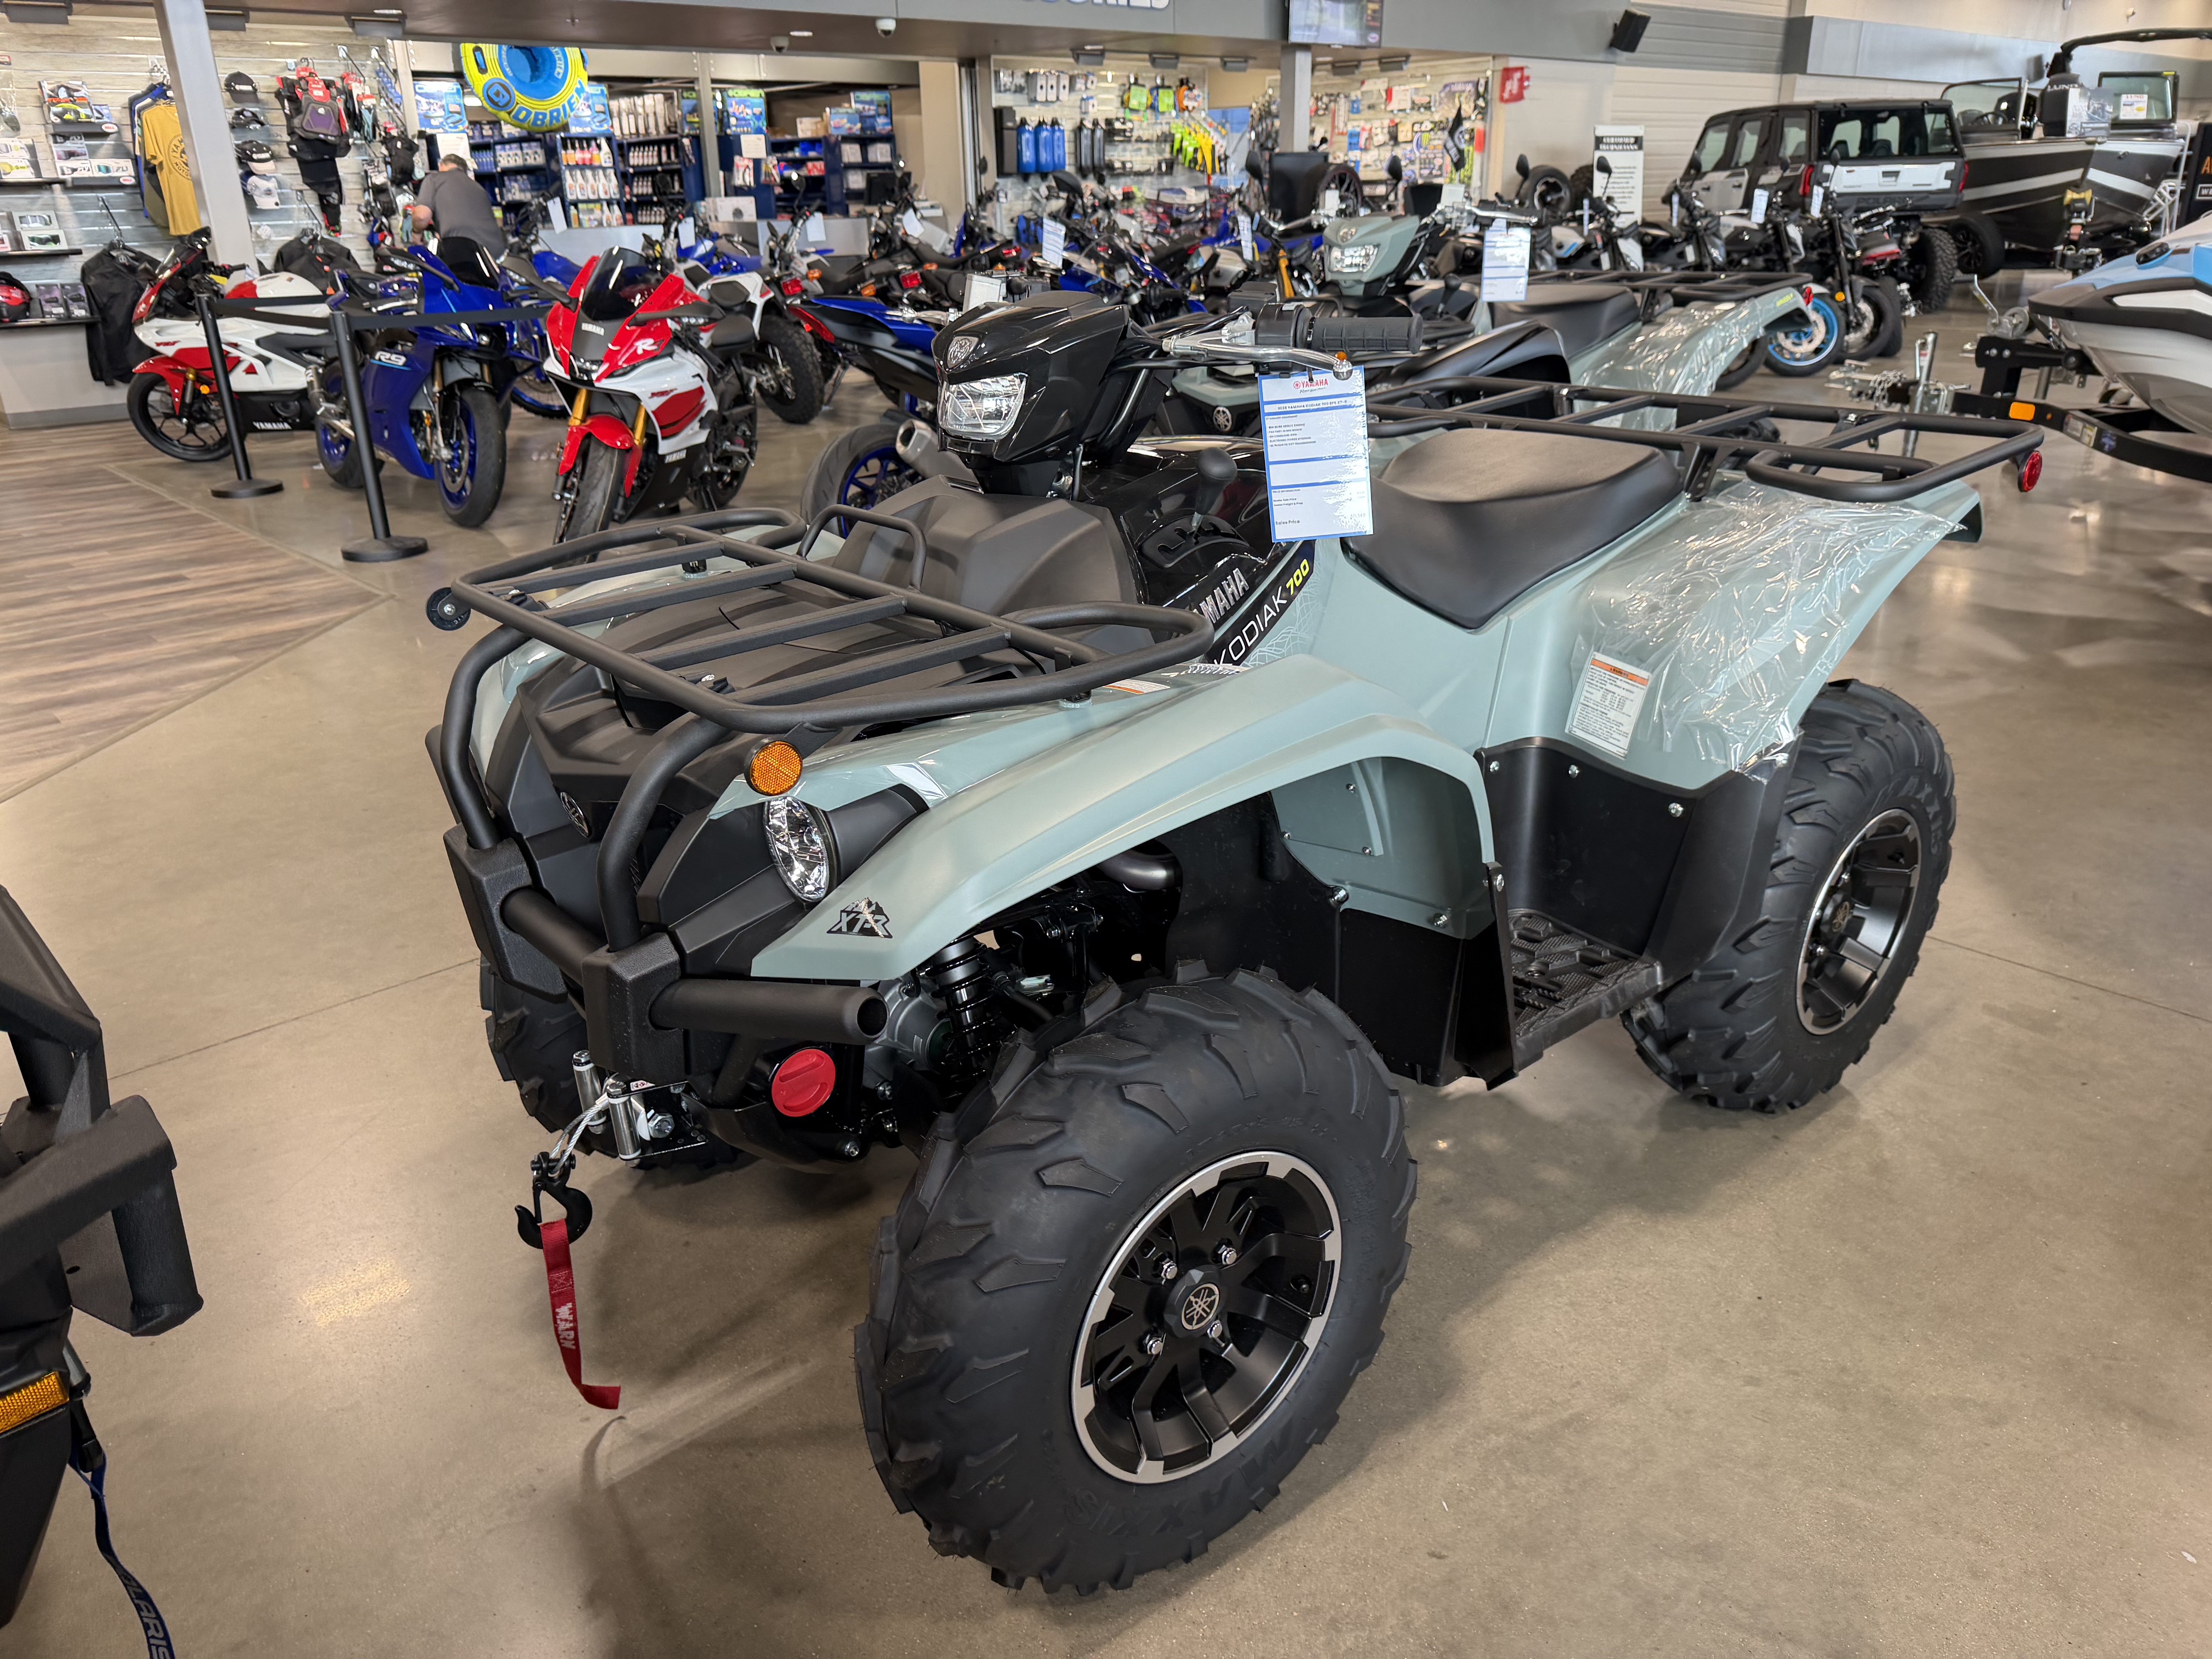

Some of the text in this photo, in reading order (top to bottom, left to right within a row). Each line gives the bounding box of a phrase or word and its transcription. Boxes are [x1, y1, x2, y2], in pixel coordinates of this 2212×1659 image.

[375, 350, 407, 366] R9
[252, 421, 292, 430] YAMAHA
[1194, 568, 1249, 624] MAHA
[1214, 559, 1310, 665] KODIAK 700
[831, 912, 889, 936] XT-R
[555, 1302, 576, 1350] WARN
